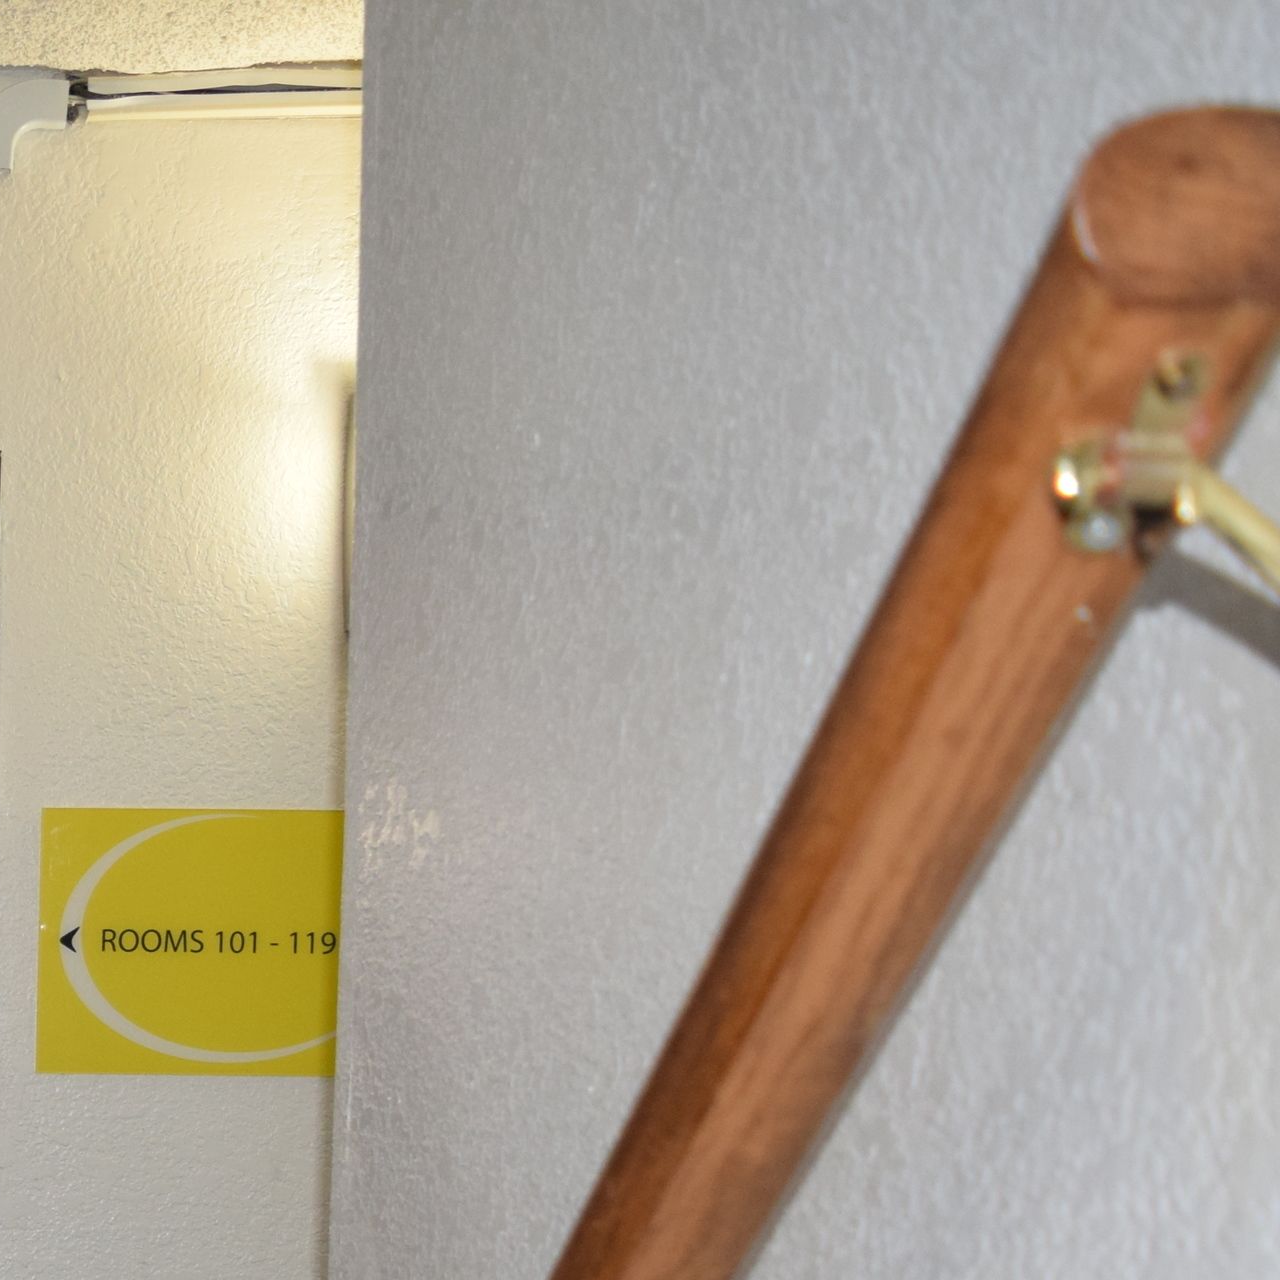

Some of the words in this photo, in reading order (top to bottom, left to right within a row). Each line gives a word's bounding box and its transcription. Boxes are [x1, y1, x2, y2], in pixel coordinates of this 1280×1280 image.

[101, 929, 205, 953] ROOMS
[215, 931, 258, 954] 101
[290, 931, 337, 954] 119
